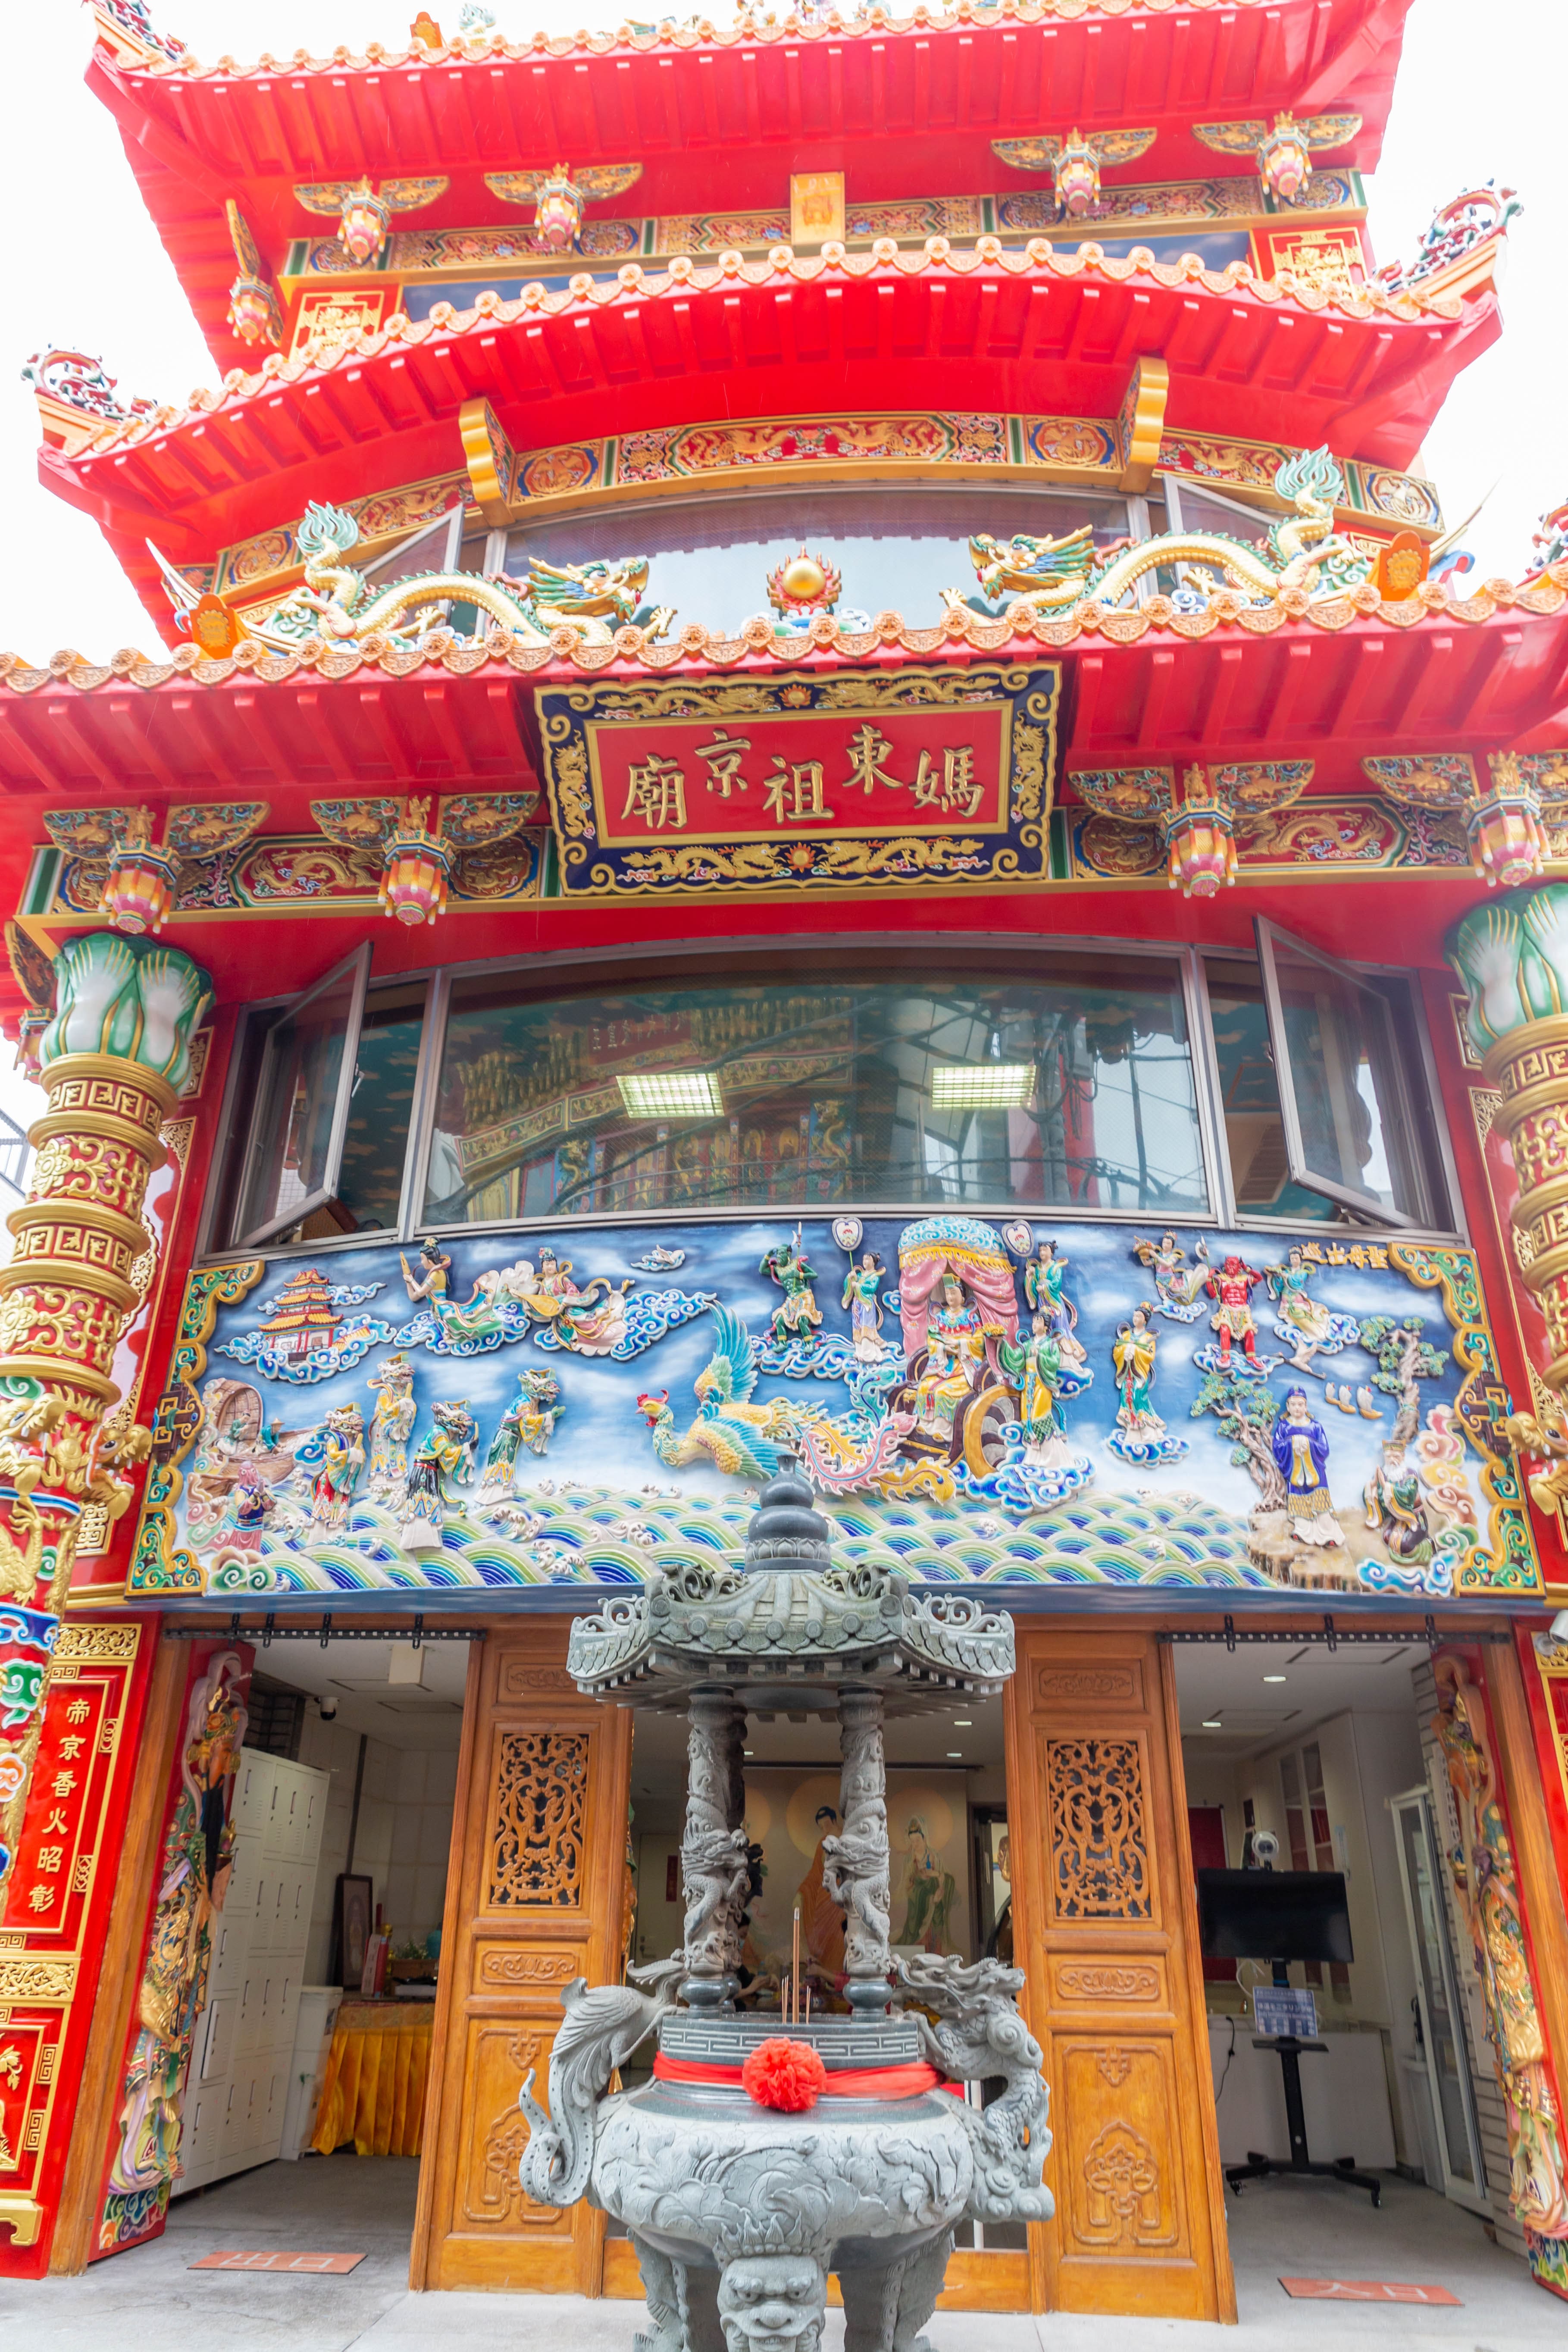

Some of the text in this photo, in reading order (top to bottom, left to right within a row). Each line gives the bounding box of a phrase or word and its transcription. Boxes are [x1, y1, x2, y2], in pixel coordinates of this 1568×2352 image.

[28, 1698, 91, 1913] 帝京香火昭彰
[219, 2253, 335, 2269] 出口
[1314, 2282, 1428, 2300] 入口
